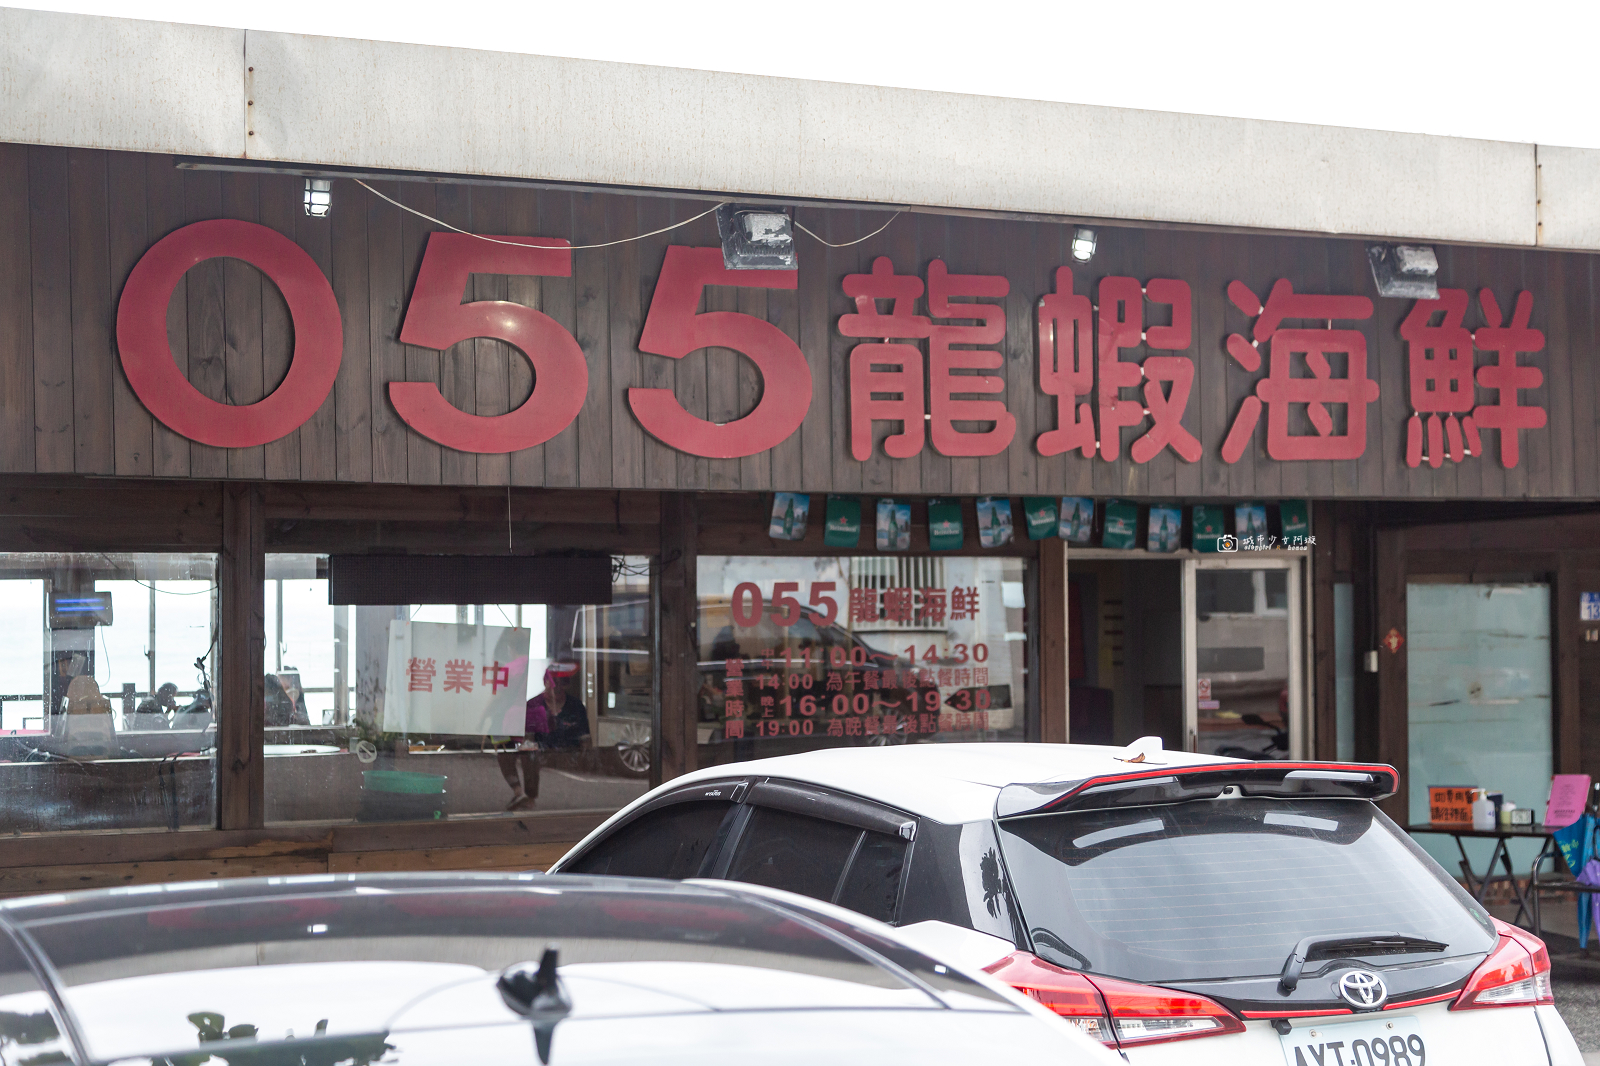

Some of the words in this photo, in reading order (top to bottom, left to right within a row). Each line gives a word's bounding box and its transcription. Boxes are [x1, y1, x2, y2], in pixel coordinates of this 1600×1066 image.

[406, 657, 509, 695] 營業中
[756, 673, 813, 691] 14:00
[826, 667, 989, 691] 為午餐最後點餐時間
[756, 719, 814, 736] 19:00
[827, 712, 989, 738] 為晚餐最後點餐時間
